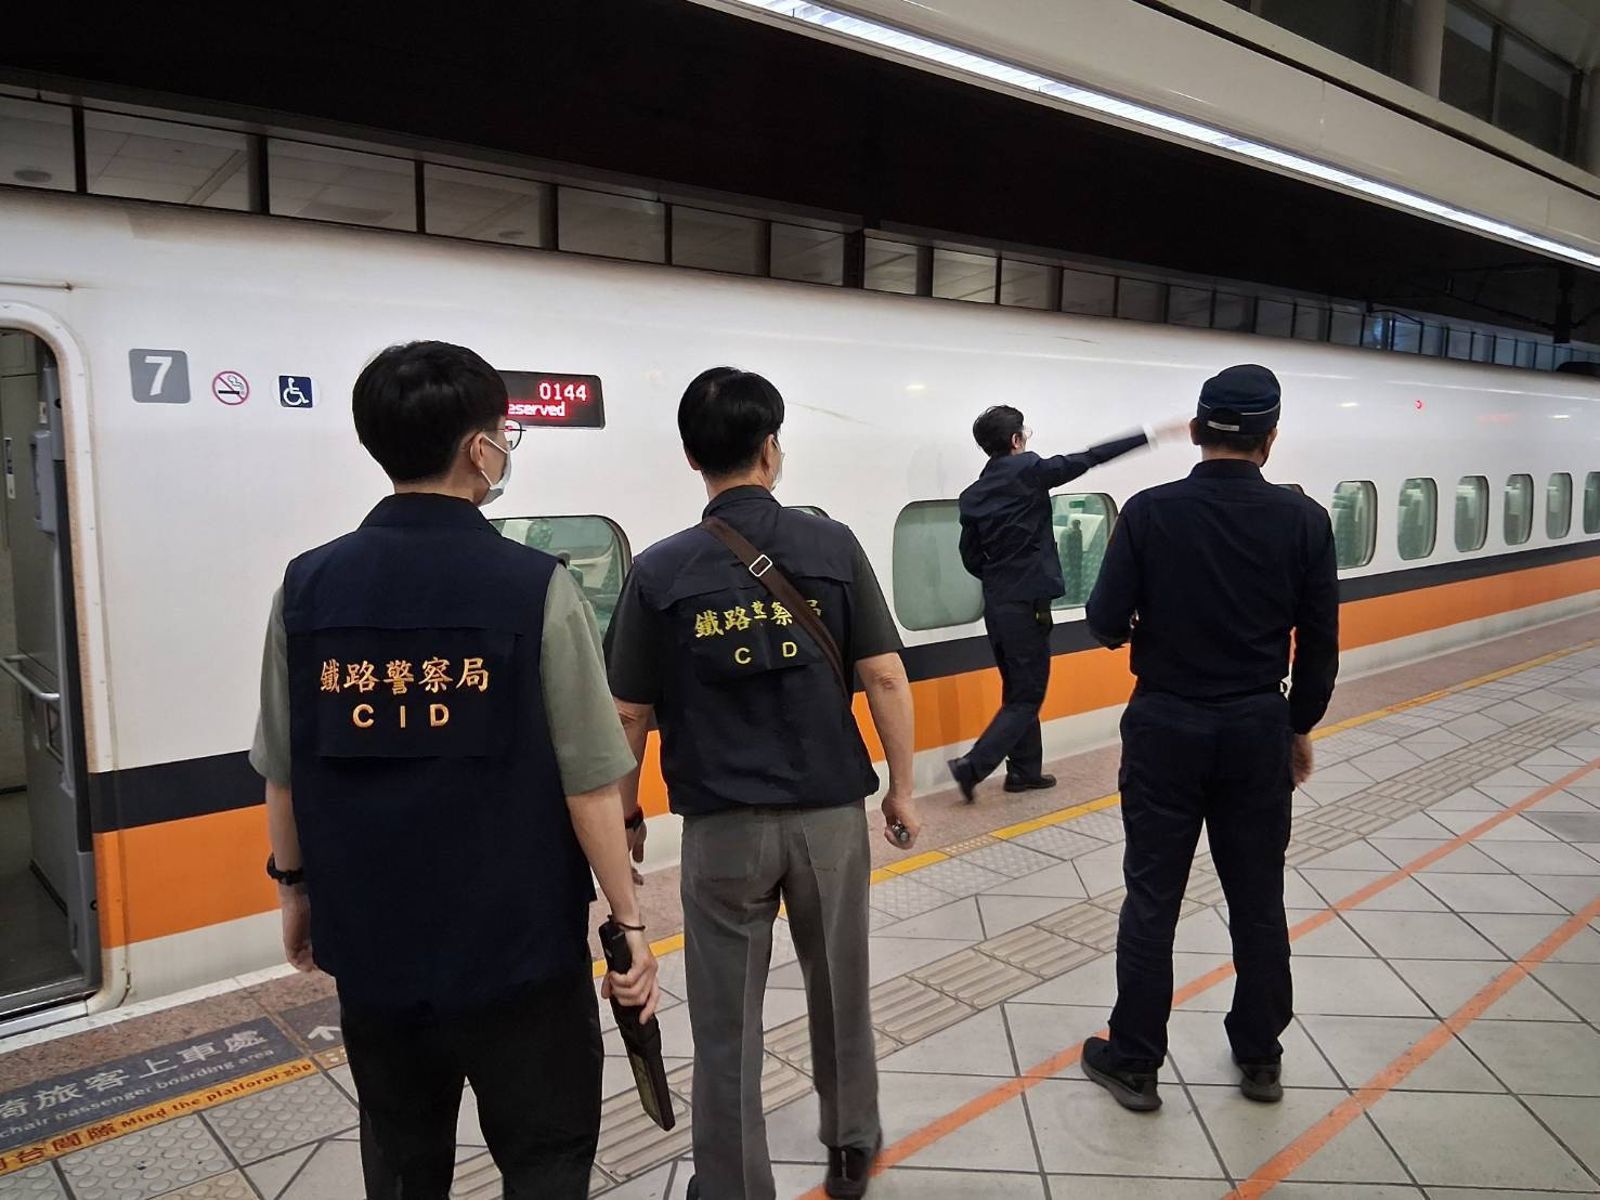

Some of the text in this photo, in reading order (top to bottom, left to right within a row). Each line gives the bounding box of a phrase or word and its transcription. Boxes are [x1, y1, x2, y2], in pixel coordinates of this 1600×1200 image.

[145, 356, 172, 396] 7
[539, 382, 587, 401] 0144
[508, 401, 566, 416] eserved
[320, 657, 491, 696] 鐵路警察局
[55, 1086, 153, 1121] passenger
[156, 1060, 235, 1090] boarding
[239, 1049, 275, 1064] area
[121, 1063, 313, 1128] Mind the platform gap
